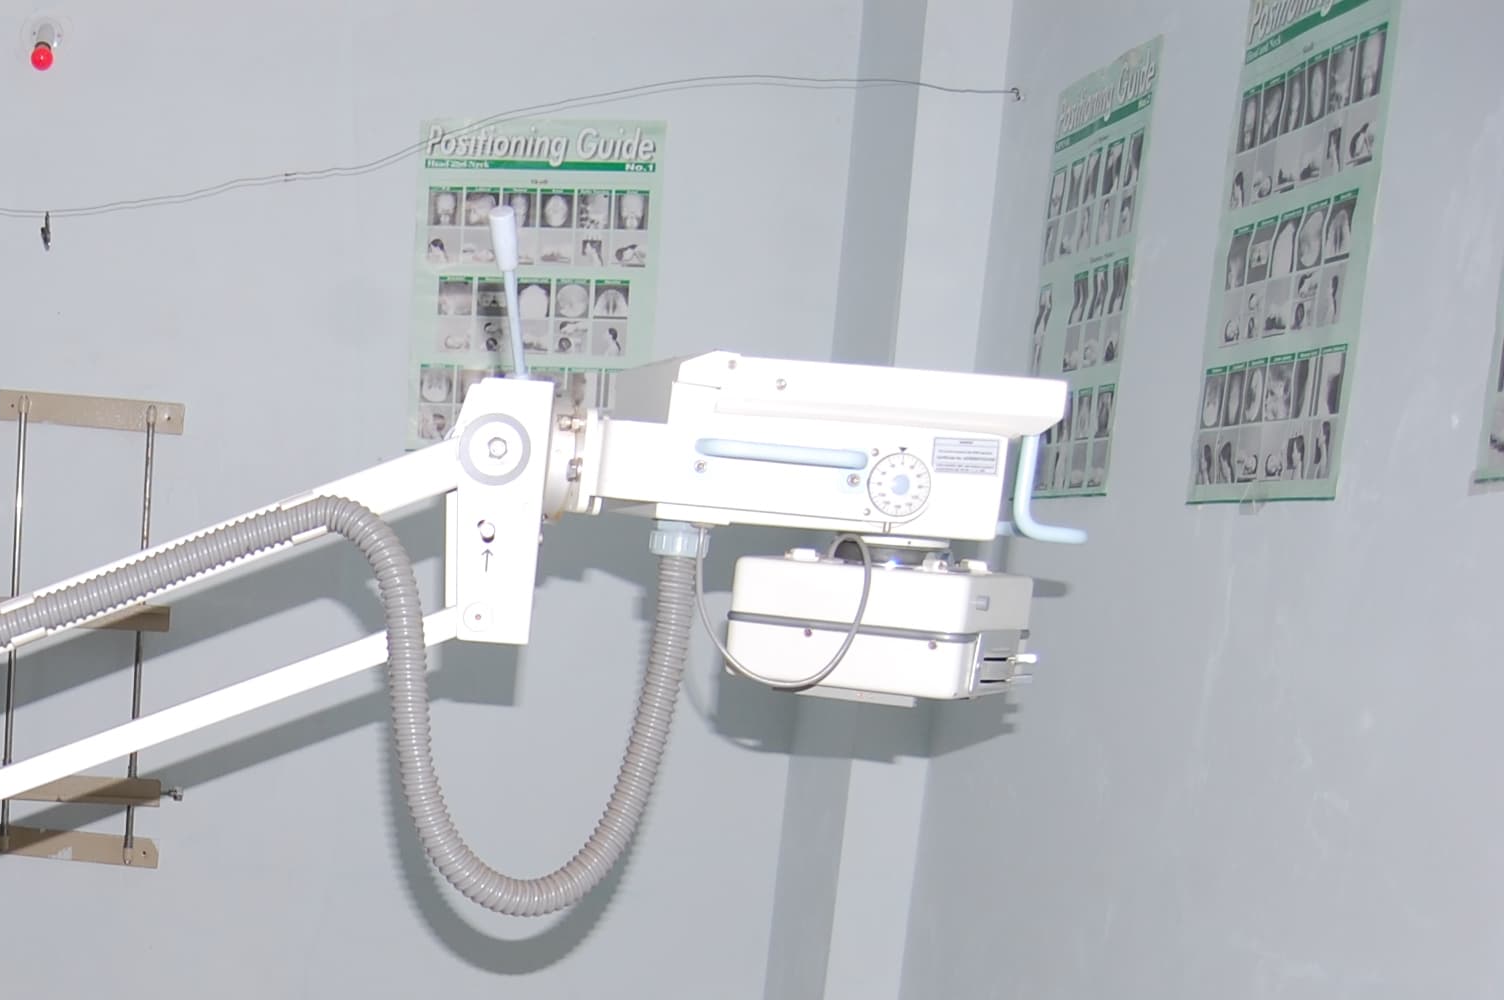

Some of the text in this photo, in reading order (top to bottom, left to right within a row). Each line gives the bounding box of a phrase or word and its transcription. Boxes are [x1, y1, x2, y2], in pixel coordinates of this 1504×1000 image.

[1248, 0, 1333, 44] Positio
[1056, 47, 1156, 137] Positioning Guide
[426, 124, 657, 166] Positioning Guide
